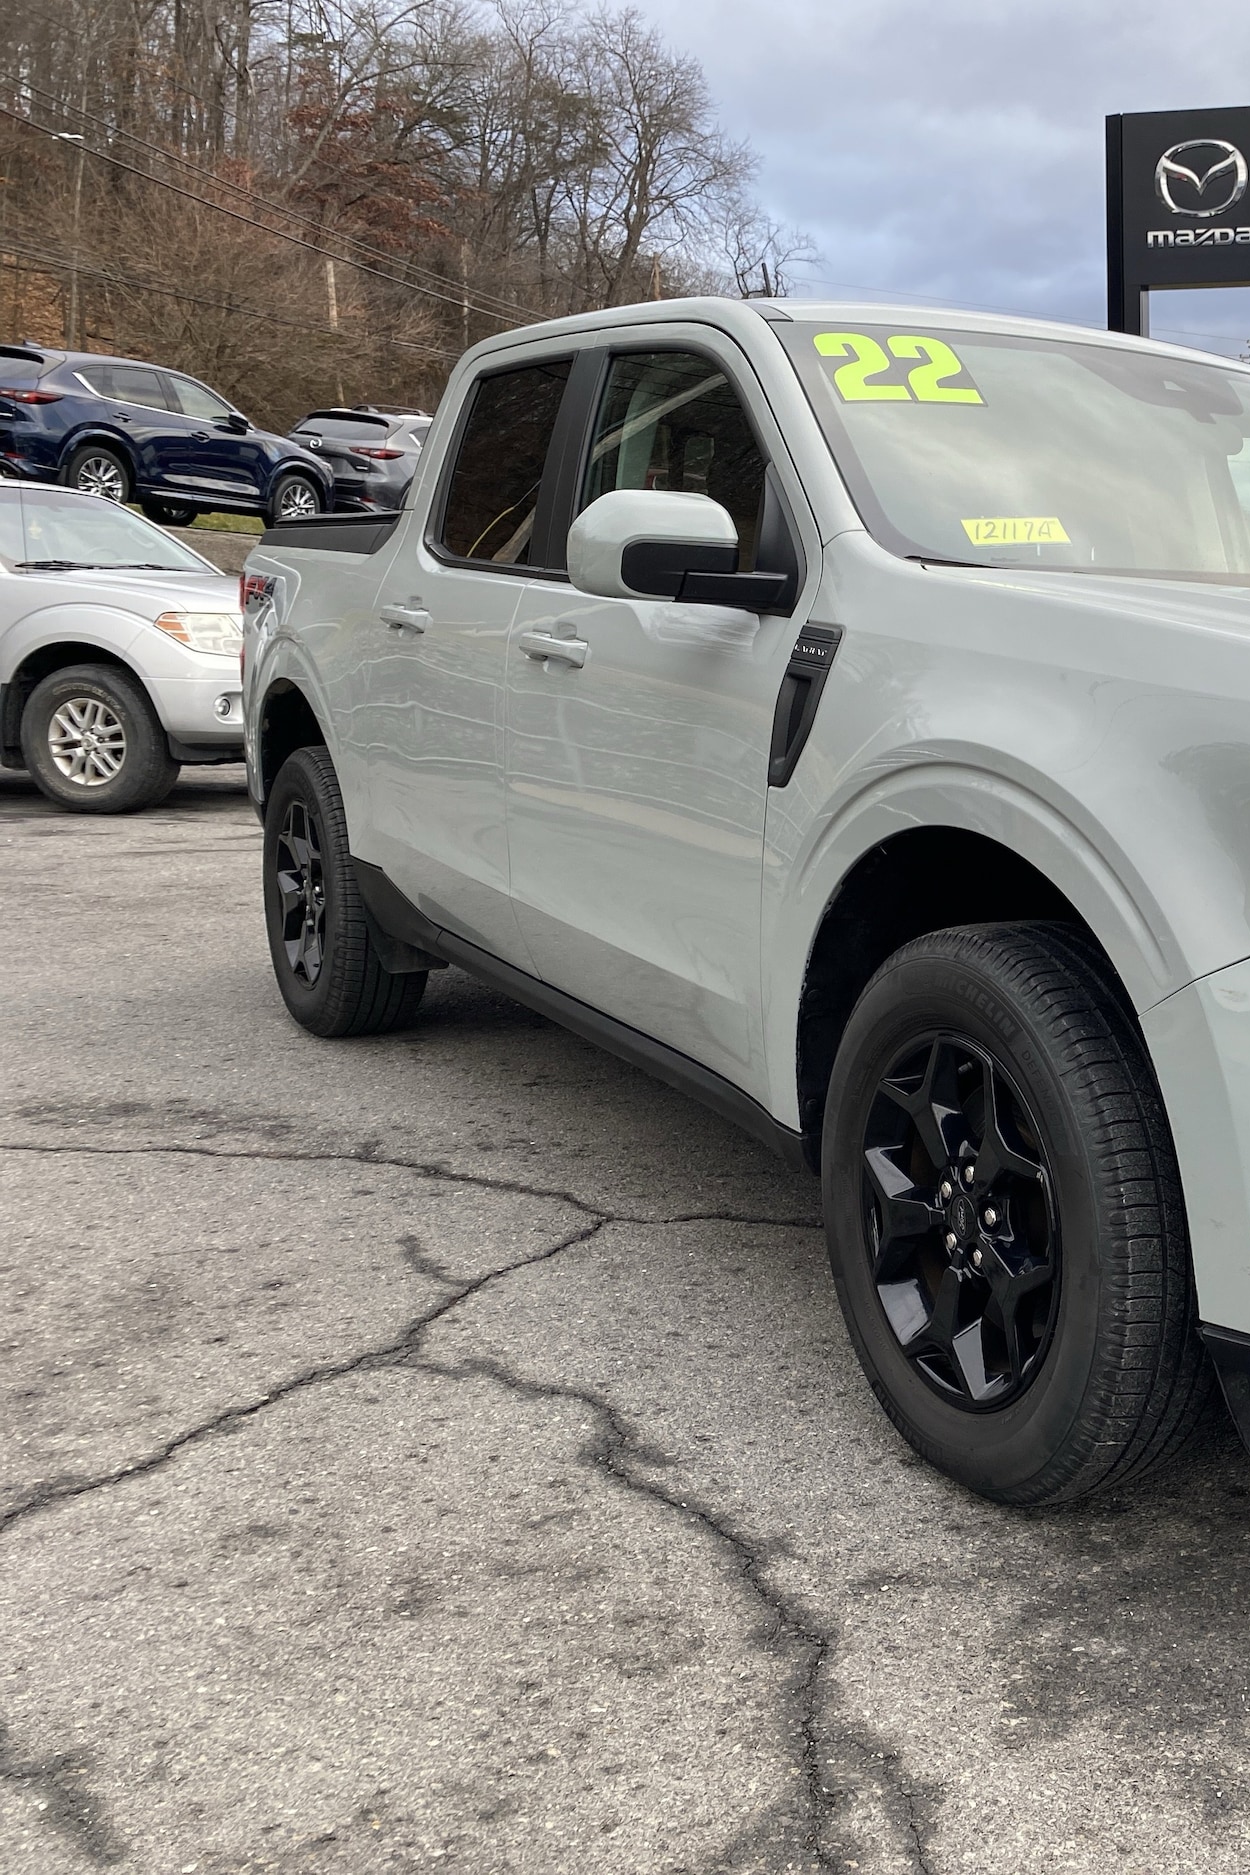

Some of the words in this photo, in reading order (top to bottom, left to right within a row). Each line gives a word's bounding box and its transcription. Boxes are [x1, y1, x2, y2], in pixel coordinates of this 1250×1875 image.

[813, 332, 985, 404] 22
[975, 521, 1055, 541] 12117A
[246, 574, 278, 605] FX4
[935, 974, 1017, 1039] MICHELIN
